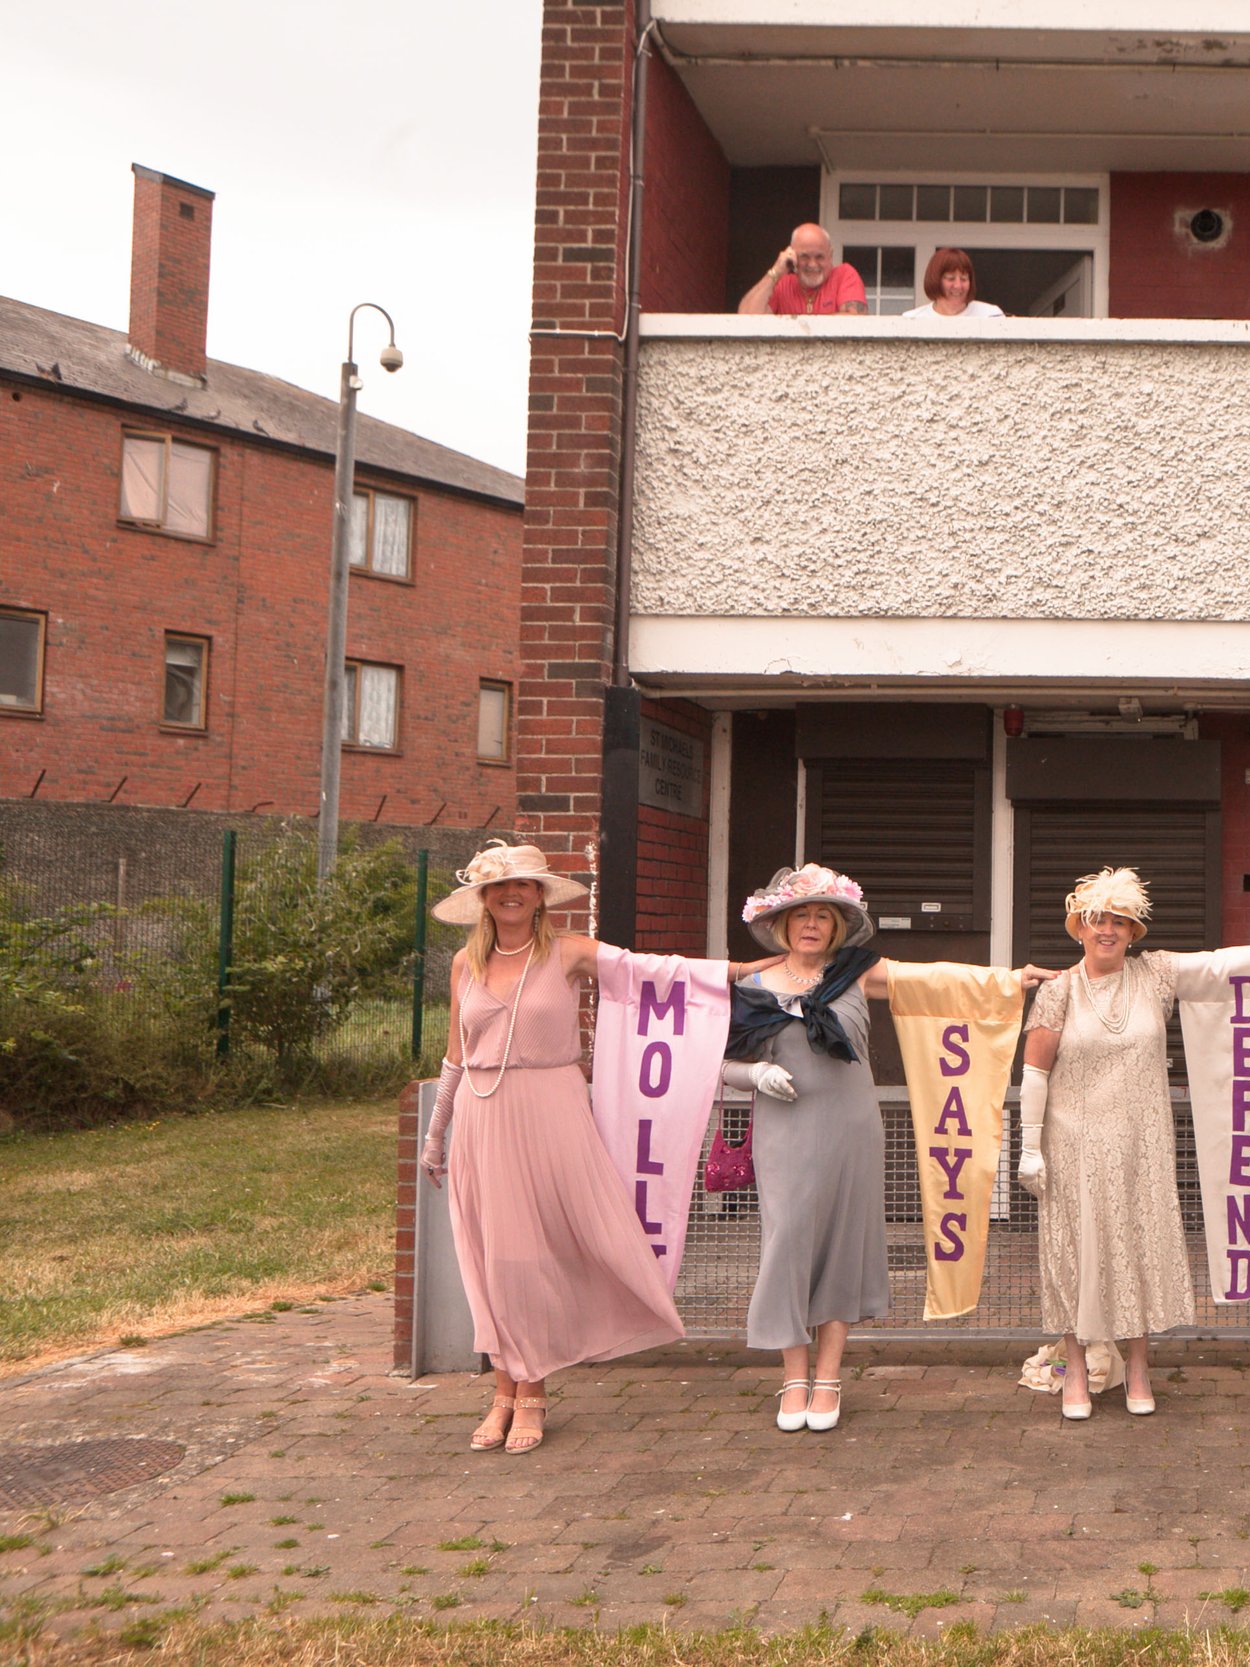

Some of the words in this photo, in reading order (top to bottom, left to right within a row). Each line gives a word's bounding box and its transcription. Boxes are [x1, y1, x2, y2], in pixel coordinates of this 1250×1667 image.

[655, 777, 682, 801] CENTRE
[635, 980, 686, 1259] MOLL
[929, 1024, 973, 1262] SAYS
